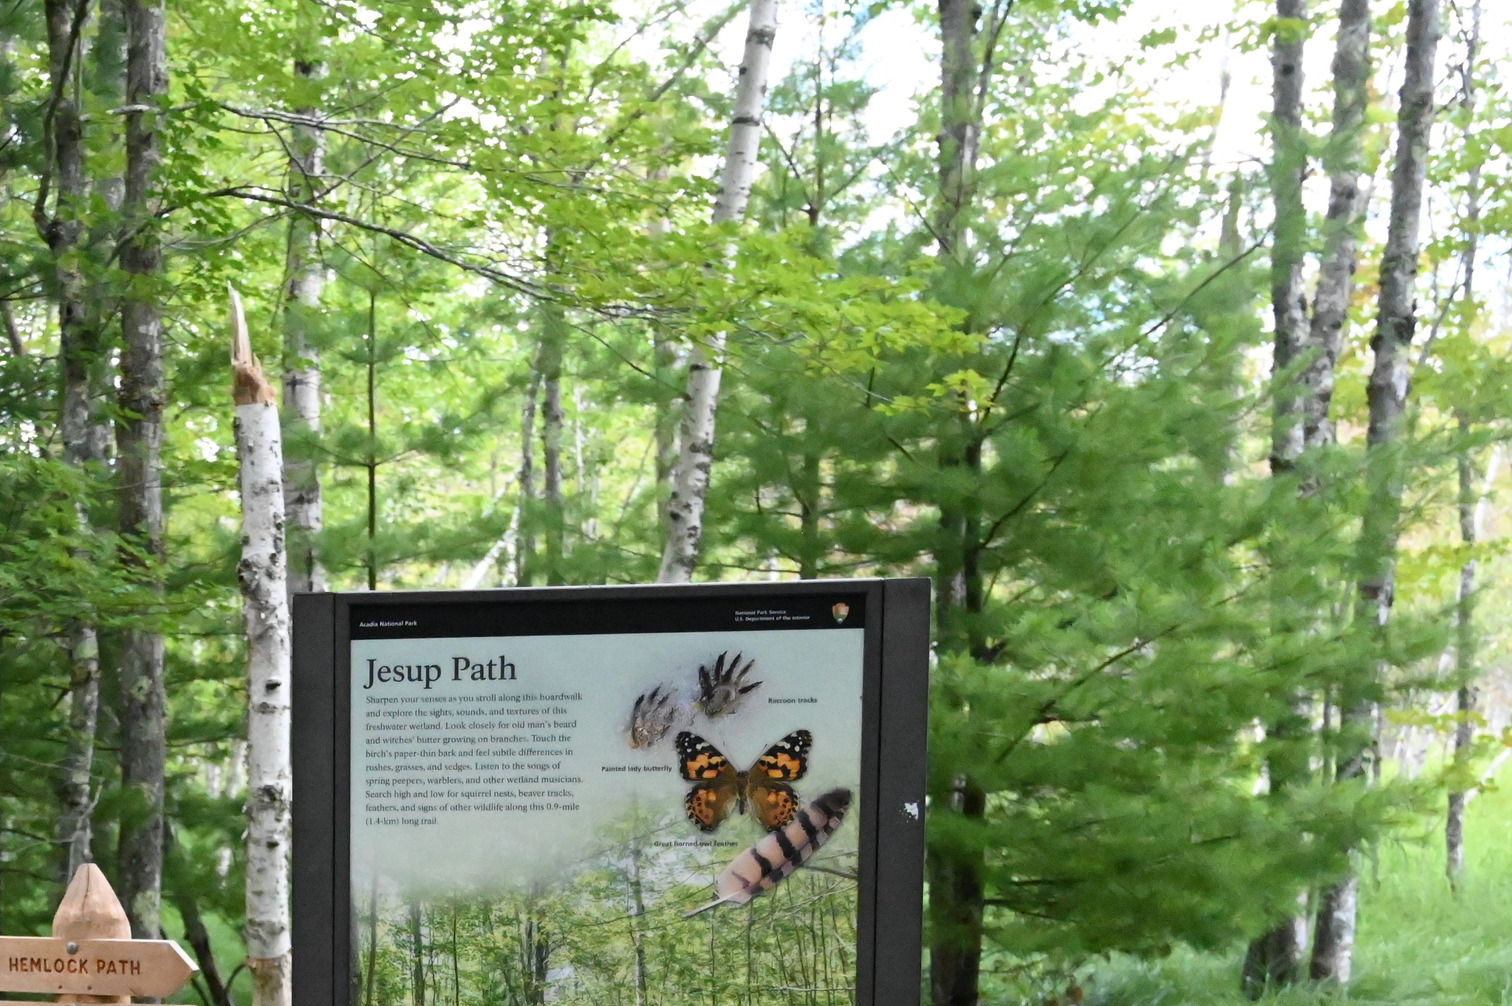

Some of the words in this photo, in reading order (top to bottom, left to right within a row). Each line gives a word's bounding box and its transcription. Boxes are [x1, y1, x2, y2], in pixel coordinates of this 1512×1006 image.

[363, 658, 442, 690] Jesup
[452, 655, 518, 681] Path
[366, 695, 398, 705] Sharpen
[498, 694, 520, 703] along
[539, 693, 583, 701] boardwalk
[382, 709, 412, 719] explore
[456, 708, 487, 717] sounds,
[506, 707, 539, 715] textures
[366, 722, 407, 730] freshwater
[468, 721, 495, 731] closely
[442, 735, 476, 745] growing
[394, 749, 436, 759] paper-thin
[518, 748, 563, 756] differences
[366, 763, 393, 772] rushes,
[444, 762, 472, 772] sedges.
[366, 776, 390, 786] spring
[427, 776, 463, 785] warblers,
[393, 790, 411, 800] high
[460, 790, 491, 799] squirrel
[493, 790, 516, 799] nests,
[366, 804, 398, 813] feathers,
[418, 803, 437, 813] signs
[505, 803, 527, 813] along
[401, 817, 419, 826] long
[8, 956, 88, 974] HEMLOCK
[97, 960, 141, 976] PATH
